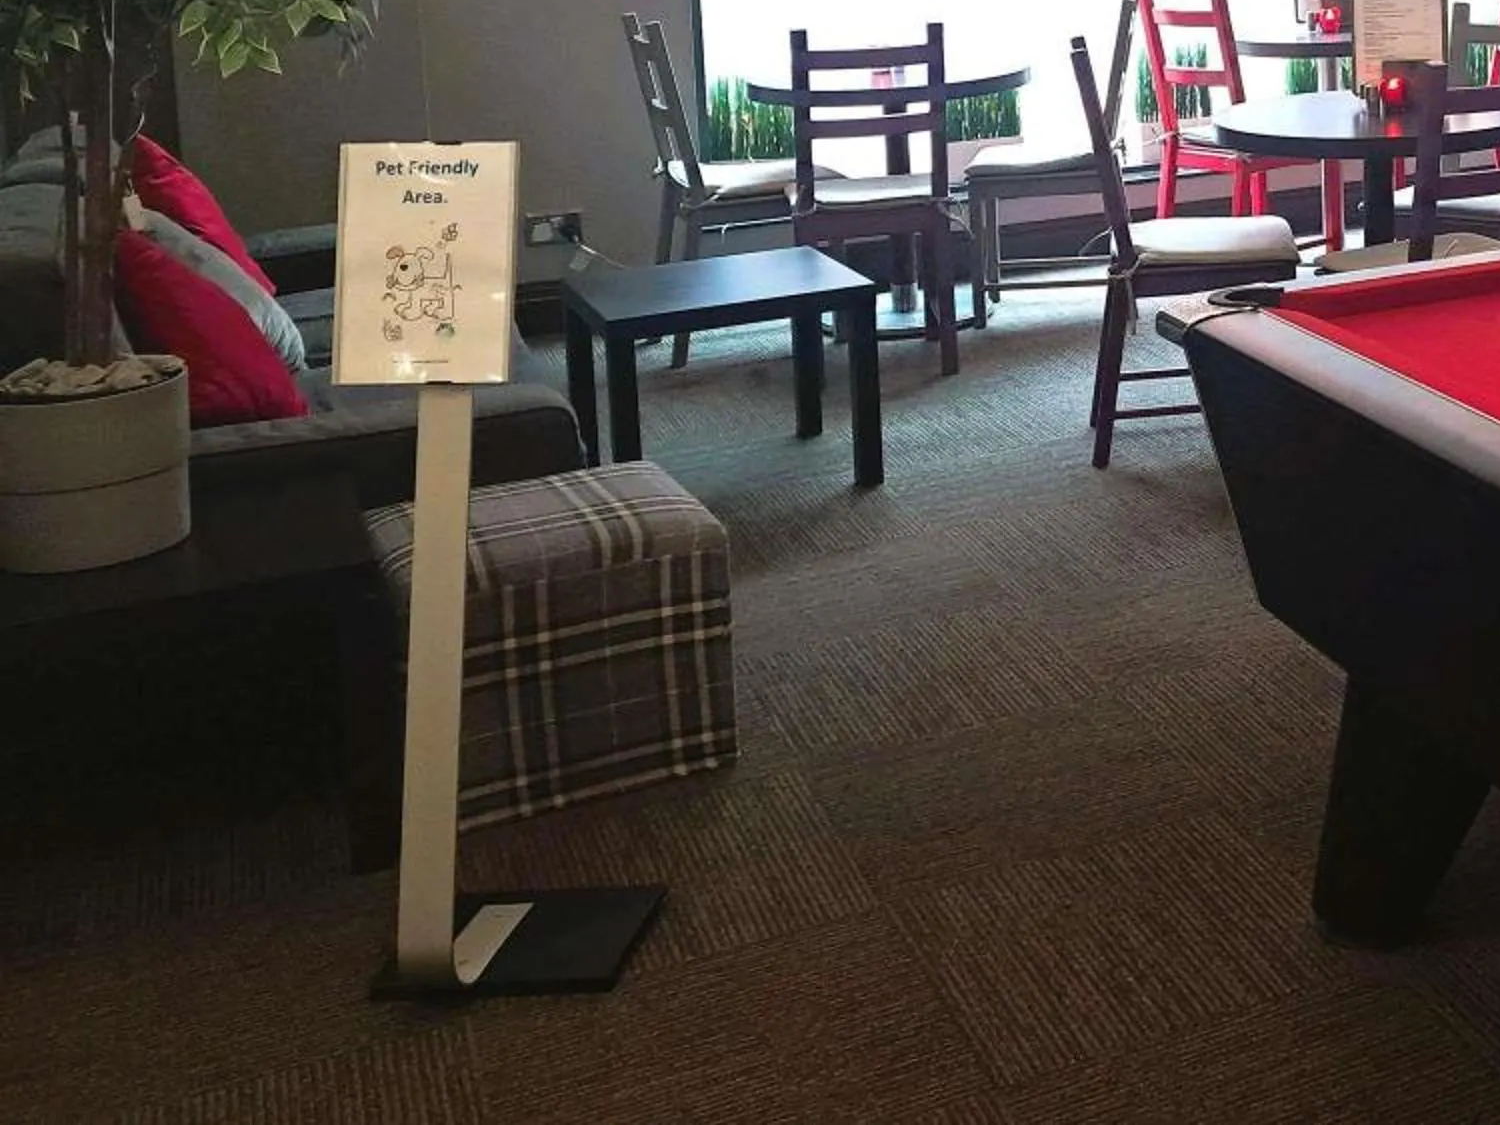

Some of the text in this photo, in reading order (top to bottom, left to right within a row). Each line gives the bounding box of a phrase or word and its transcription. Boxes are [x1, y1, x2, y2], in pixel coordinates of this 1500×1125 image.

[376, 159, 478, 178] Pet Friendly
[402, 189, 448, 204] Area.
